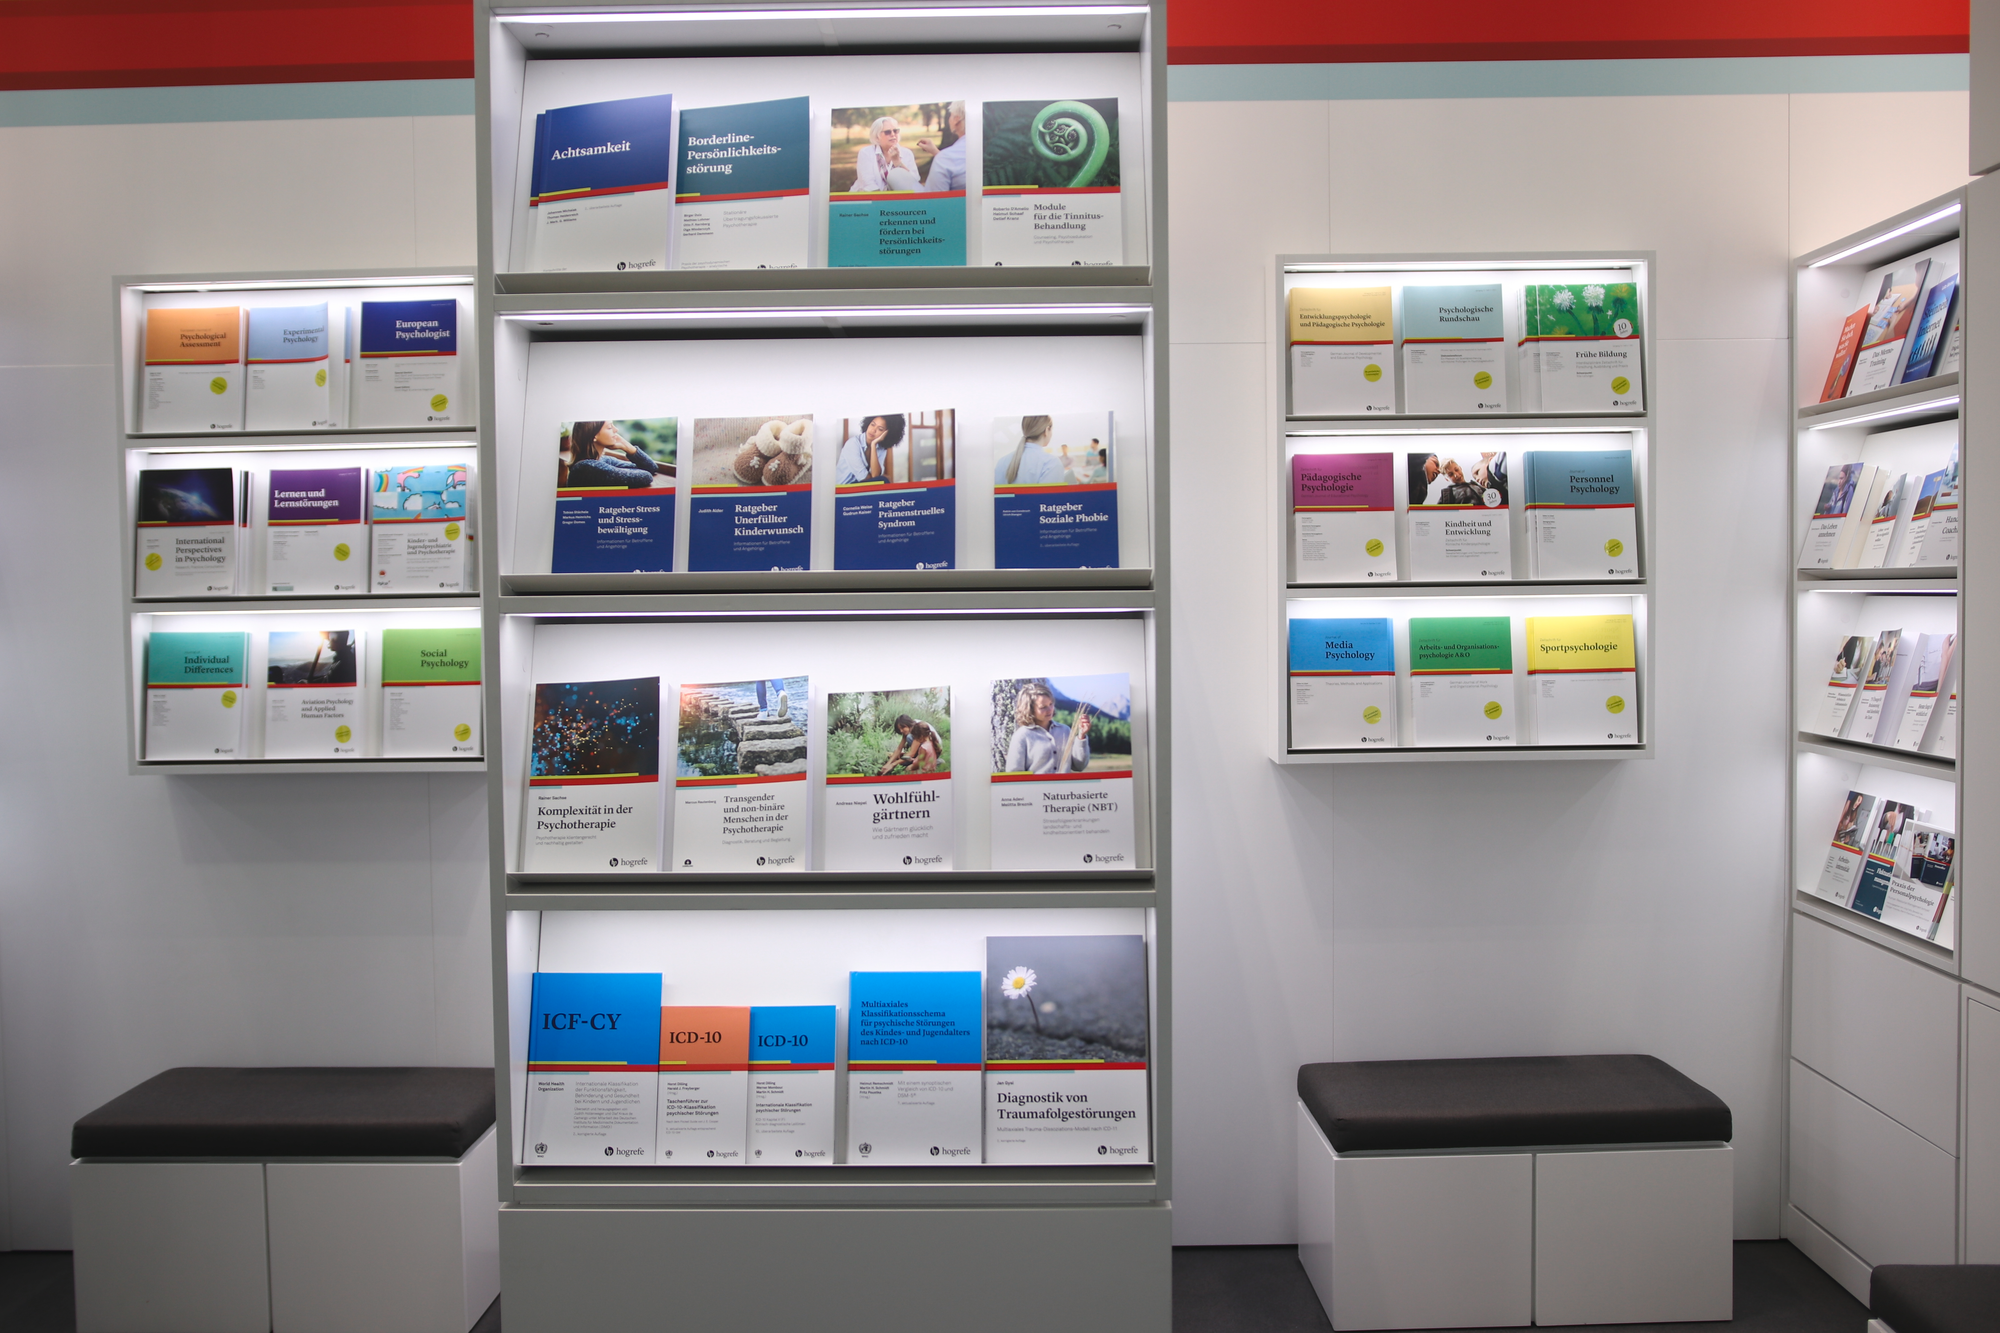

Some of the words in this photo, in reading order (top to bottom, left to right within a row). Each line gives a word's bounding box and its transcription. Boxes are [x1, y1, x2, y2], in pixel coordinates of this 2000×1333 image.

[688, 133, 754, 146] Borderline-
[552, 140, 631, 160] Achtsamkeit
[687, 144, 782, 160] Persönlichkeits-
[686, 163, 732, 174] störung
[1034, 222, 1086, 230] Behandlung
[879, 236, 945, 244] Persönlichkeits-
[628, 259, 656, 270] hogrefe
[1440, 306, 1493, 314] Psychologische
[396, 320, 438, 329] European
[283, 326, 324, 336] Experimental
[396, 330, 450, 340] Psychologist
[283, 335, 318, 344] Psychology
[1301, 473, 1362, 482] Pädagogische
[1301, 483, 1354, 493] Psychologie
[1570, 485, 1620, 494] Psychology
[308, 489, 325, 497] und
[1487, 492, 1496, 500] 30
[274, 499, 338, 509] Lernstörungen
[879, 500, 915, 509] Ratgeber
[1040, 503, 1083, 513] Ratgeber
[599, 506, 635, 515] Ratgeber
[735, 504, 778, 514] Ratgeber
[879, 507, 945, 518] Prämenstruelles
[735, 515, 788, 524] Unerfüllter
[1040, 514, 1074, 524] Soziale
[1076, 513, 1108, 522] Phobie
[878, 520, 915, 529] Syndrom
[598, 526, 648, 535] bewältigung
[734, 525, 804, 536] Kinderwunsch
[175, 546, 221, 554] Perspectives
[1540, 642, 1618, 653] Sportpsychologie
[1325, 651, 1375, 660] Psychology
[421, 659, 469, 668] Psychology
[724, 794, 775, 803] Transgender
[873, 790, 940, 804] Wohlfühl-
[1043, 791, 1108, 800] Naturbasierte
[538, 805, 601, 818] Komplexität
[604, 805, 613, 814] in
[616, 805, 633, 813] der
[741, 803, 785, 812] non-binäre
[1043, 804, 1086, 814] Therapie
[1088, 802, 1118, 813] (NBT)
[723, 815, 764, 823] Menschen
[873, 809, 930, 824] gärtnern
[537, 819, 616, 832] Psychotherapie
[723, 824, 784, 835] Psychotherapie
[621, 858, 648, 867] hogrefe
[768, 856, 795, 865] hogrefe
[915, 855, 942, 865] hogrefe
[1095, 854, 1124, 863] hogrefe
[1891, 880, 1906, 889] Praxis
[1890, 887, 1934, 906] Personalpsychologie
[543, 1013, 622, 1030] ICF-CY
[874, 1020, 914, 1028] psychische
[916, 1019, 955, 1027] Störungen
[922, 1028, 970, 1037] Jugendalters
[670, 1032, 721, 1043] ICD-10
[758, 1035, 808, 1046] ICD-10
[997, 1092, 1063, 1106] Diagnostik
[1066, 1094, 1088, 1102] von
[997, 1108, 1136, 1122] Traumafolgestörungen
[616, 1148, 644, 1157] hogrefe
[943, 1147, 970, 1156] hogrefe
[1110, 1146, 1138, 1156] hogrefe
